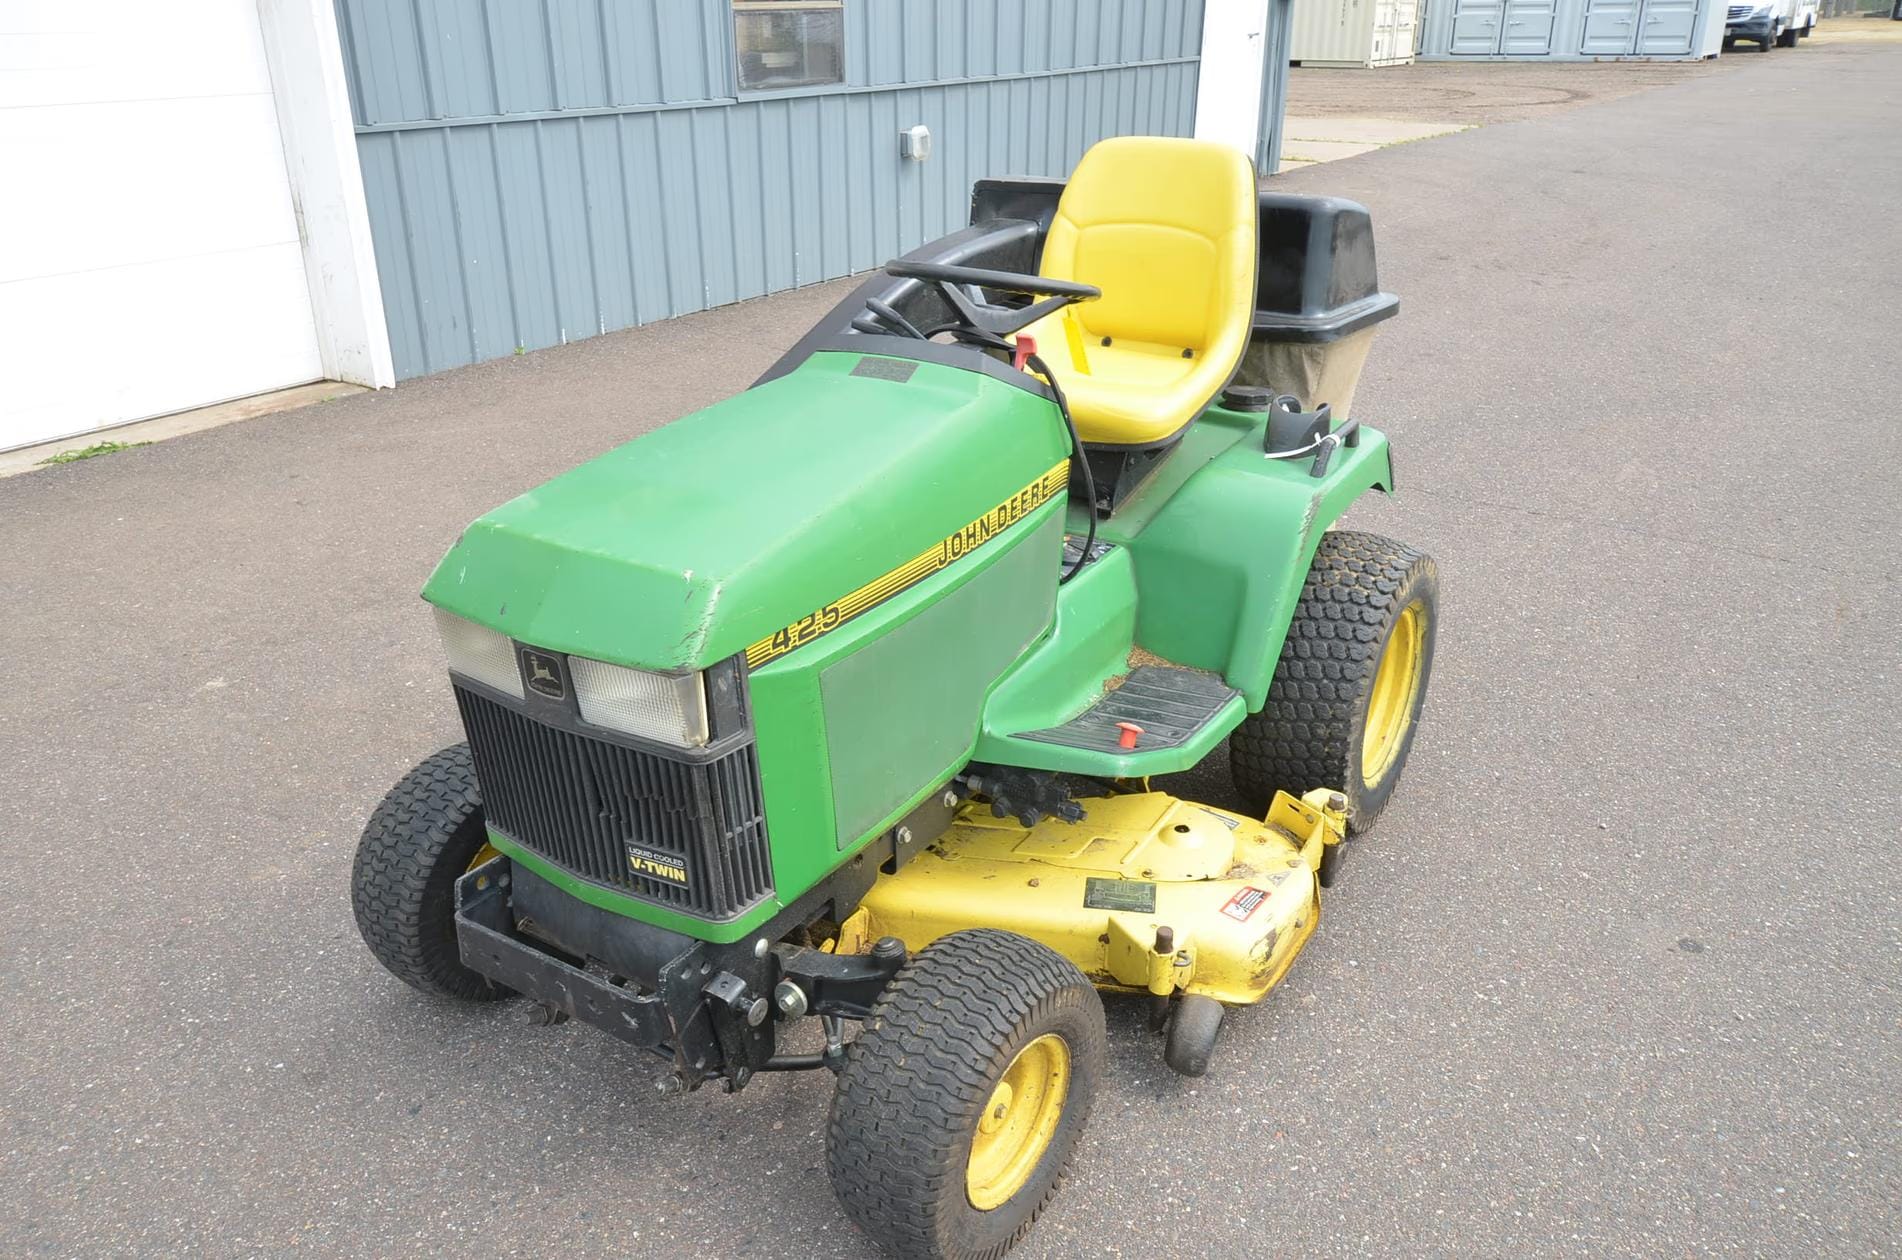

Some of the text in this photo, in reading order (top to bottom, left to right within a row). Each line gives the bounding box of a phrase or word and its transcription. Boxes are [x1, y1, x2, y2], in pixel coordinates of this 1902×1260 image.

[938, 476, 1050, 566] JOHN DEERE
[771, 602, 841, 653] 425
[628, 846, 684, 867] LIQUID COOLED
[630, 856, 686, 882] V-TWIN
